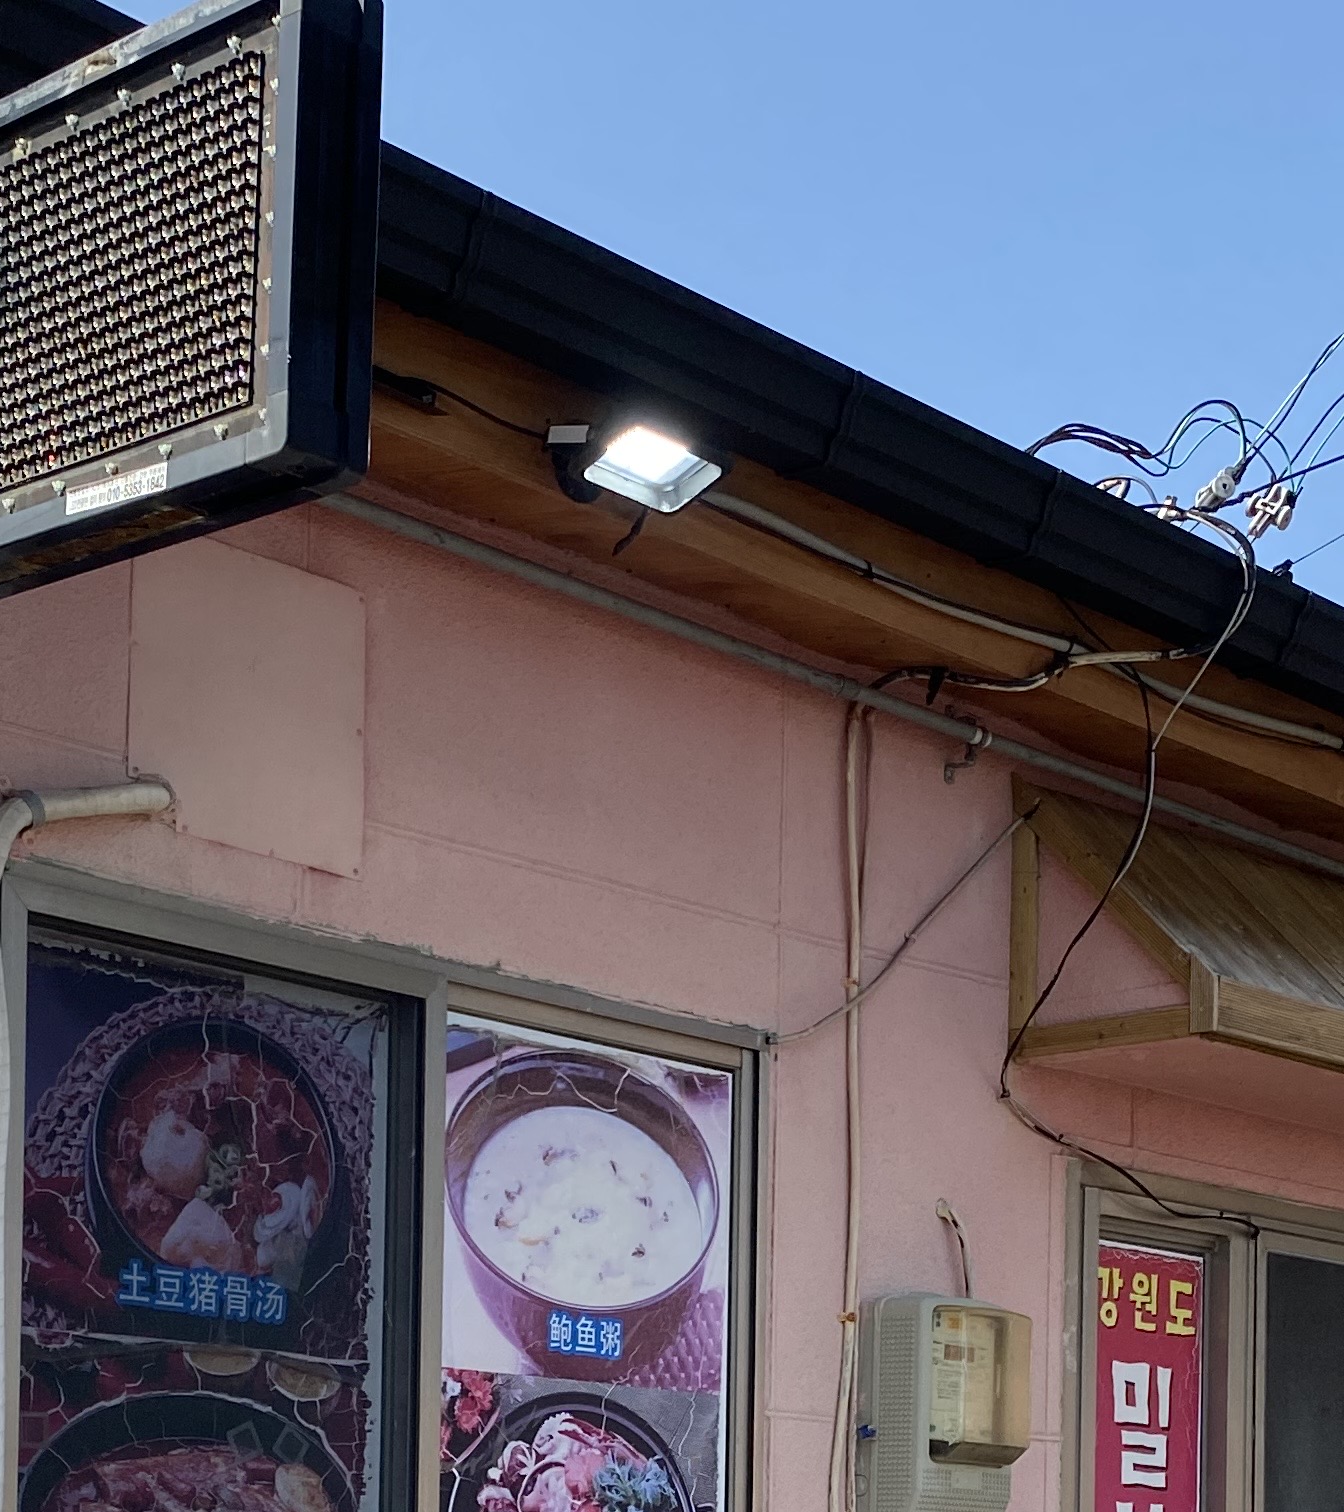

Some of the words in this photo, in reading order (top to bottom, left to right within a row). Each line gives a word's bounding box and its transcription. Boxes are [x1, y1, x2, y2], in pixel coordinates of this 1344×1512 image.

[119, 1262, 285, 1320] 土豆猪骨汤
[1098, 1266, 1196, 1336] 강원도
[549, 1313, 621, 1357] 鲍鱼粥
